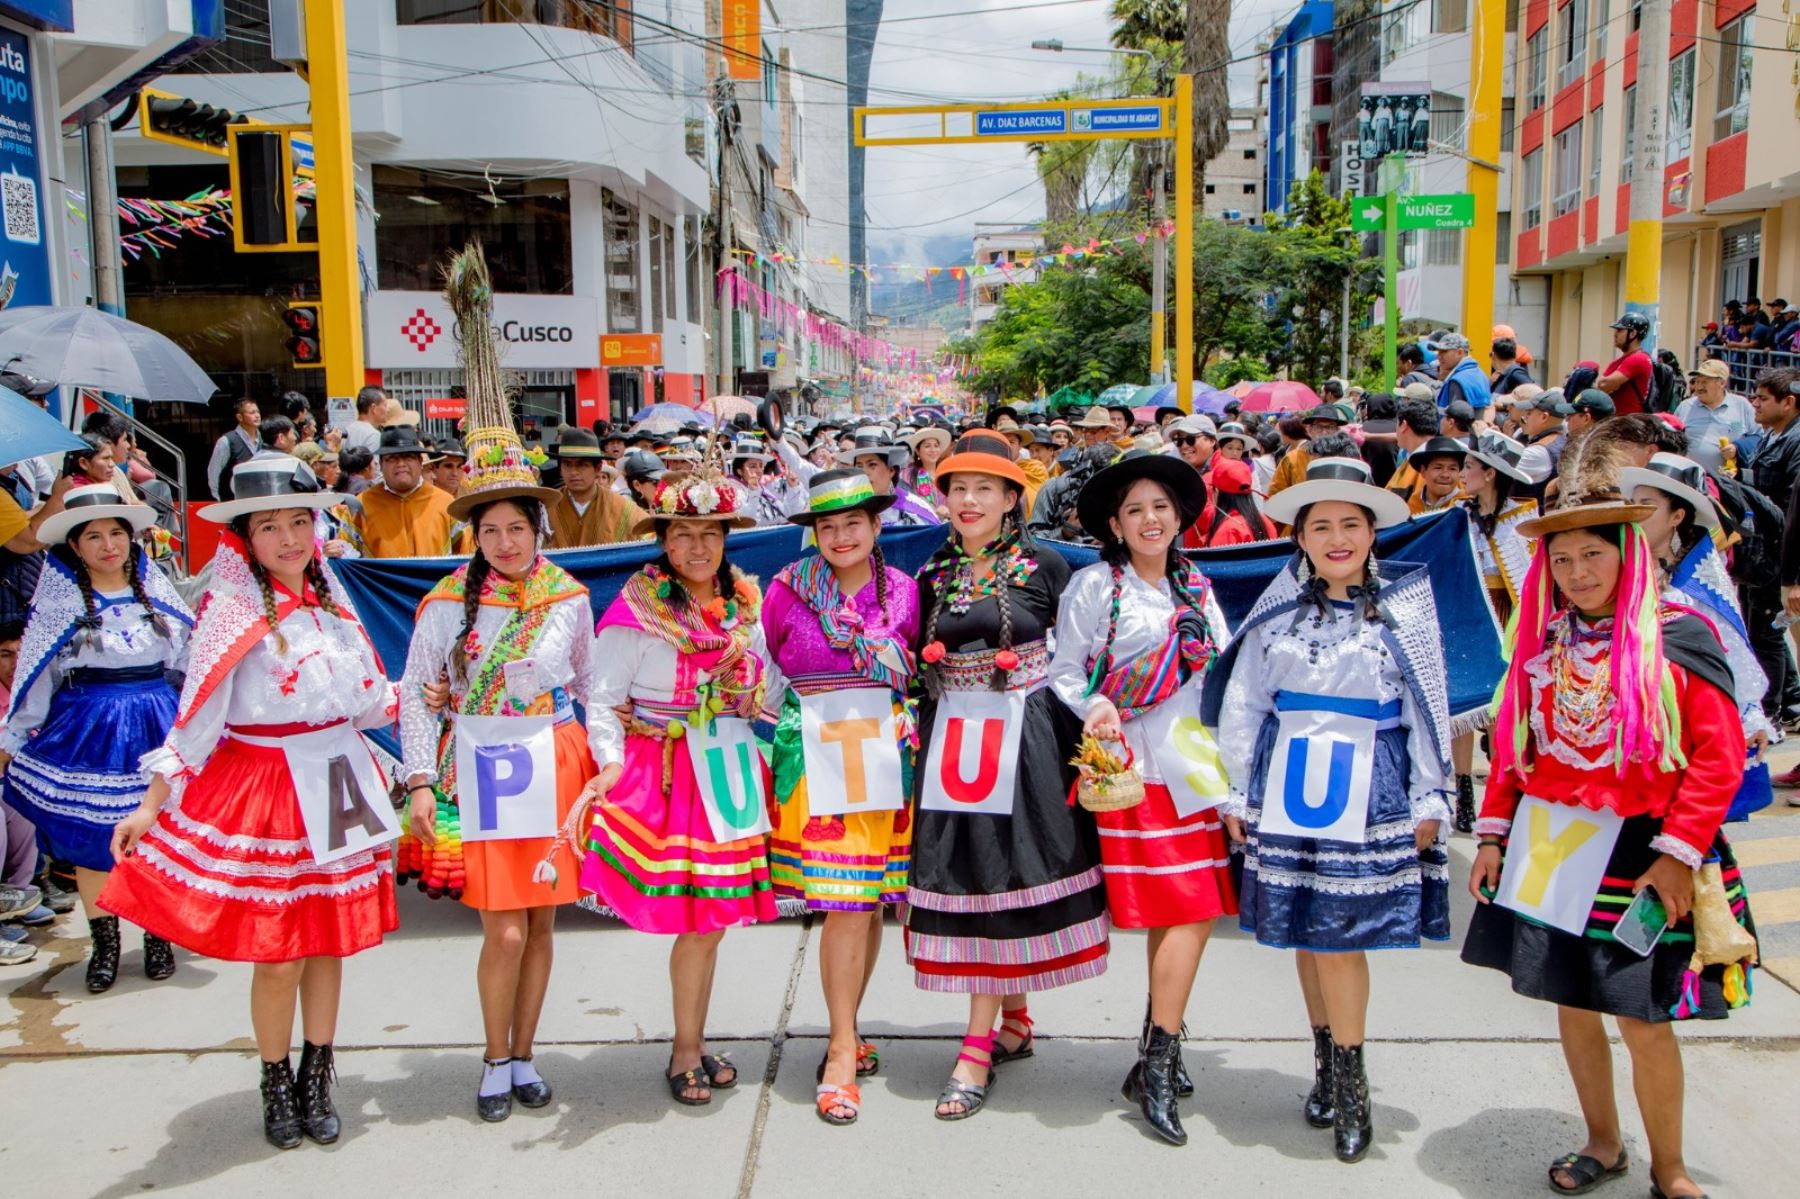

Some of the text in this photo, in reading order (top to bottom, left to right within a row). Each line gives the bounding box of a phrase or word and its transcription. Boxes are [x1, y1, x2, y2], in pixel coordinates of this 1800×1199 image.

[982, 115, 1062, 128] AV. DIAZ BARCENAS
[1405, 202, 1453, 217] NUÑEZ
[1435, 218, 1464, 227] Cuadra
[474, 743, 534, 831] P
[705, 742, 759, 830] U
[820, 717, 881, 804] T
[940, 717, 1005, 804] U
[1173, 716, 1229, 797] S
[1284, 737, 1356, 829] U
[327, 753, 389, 852] A
[1516, 804, 1601, 908] Y
